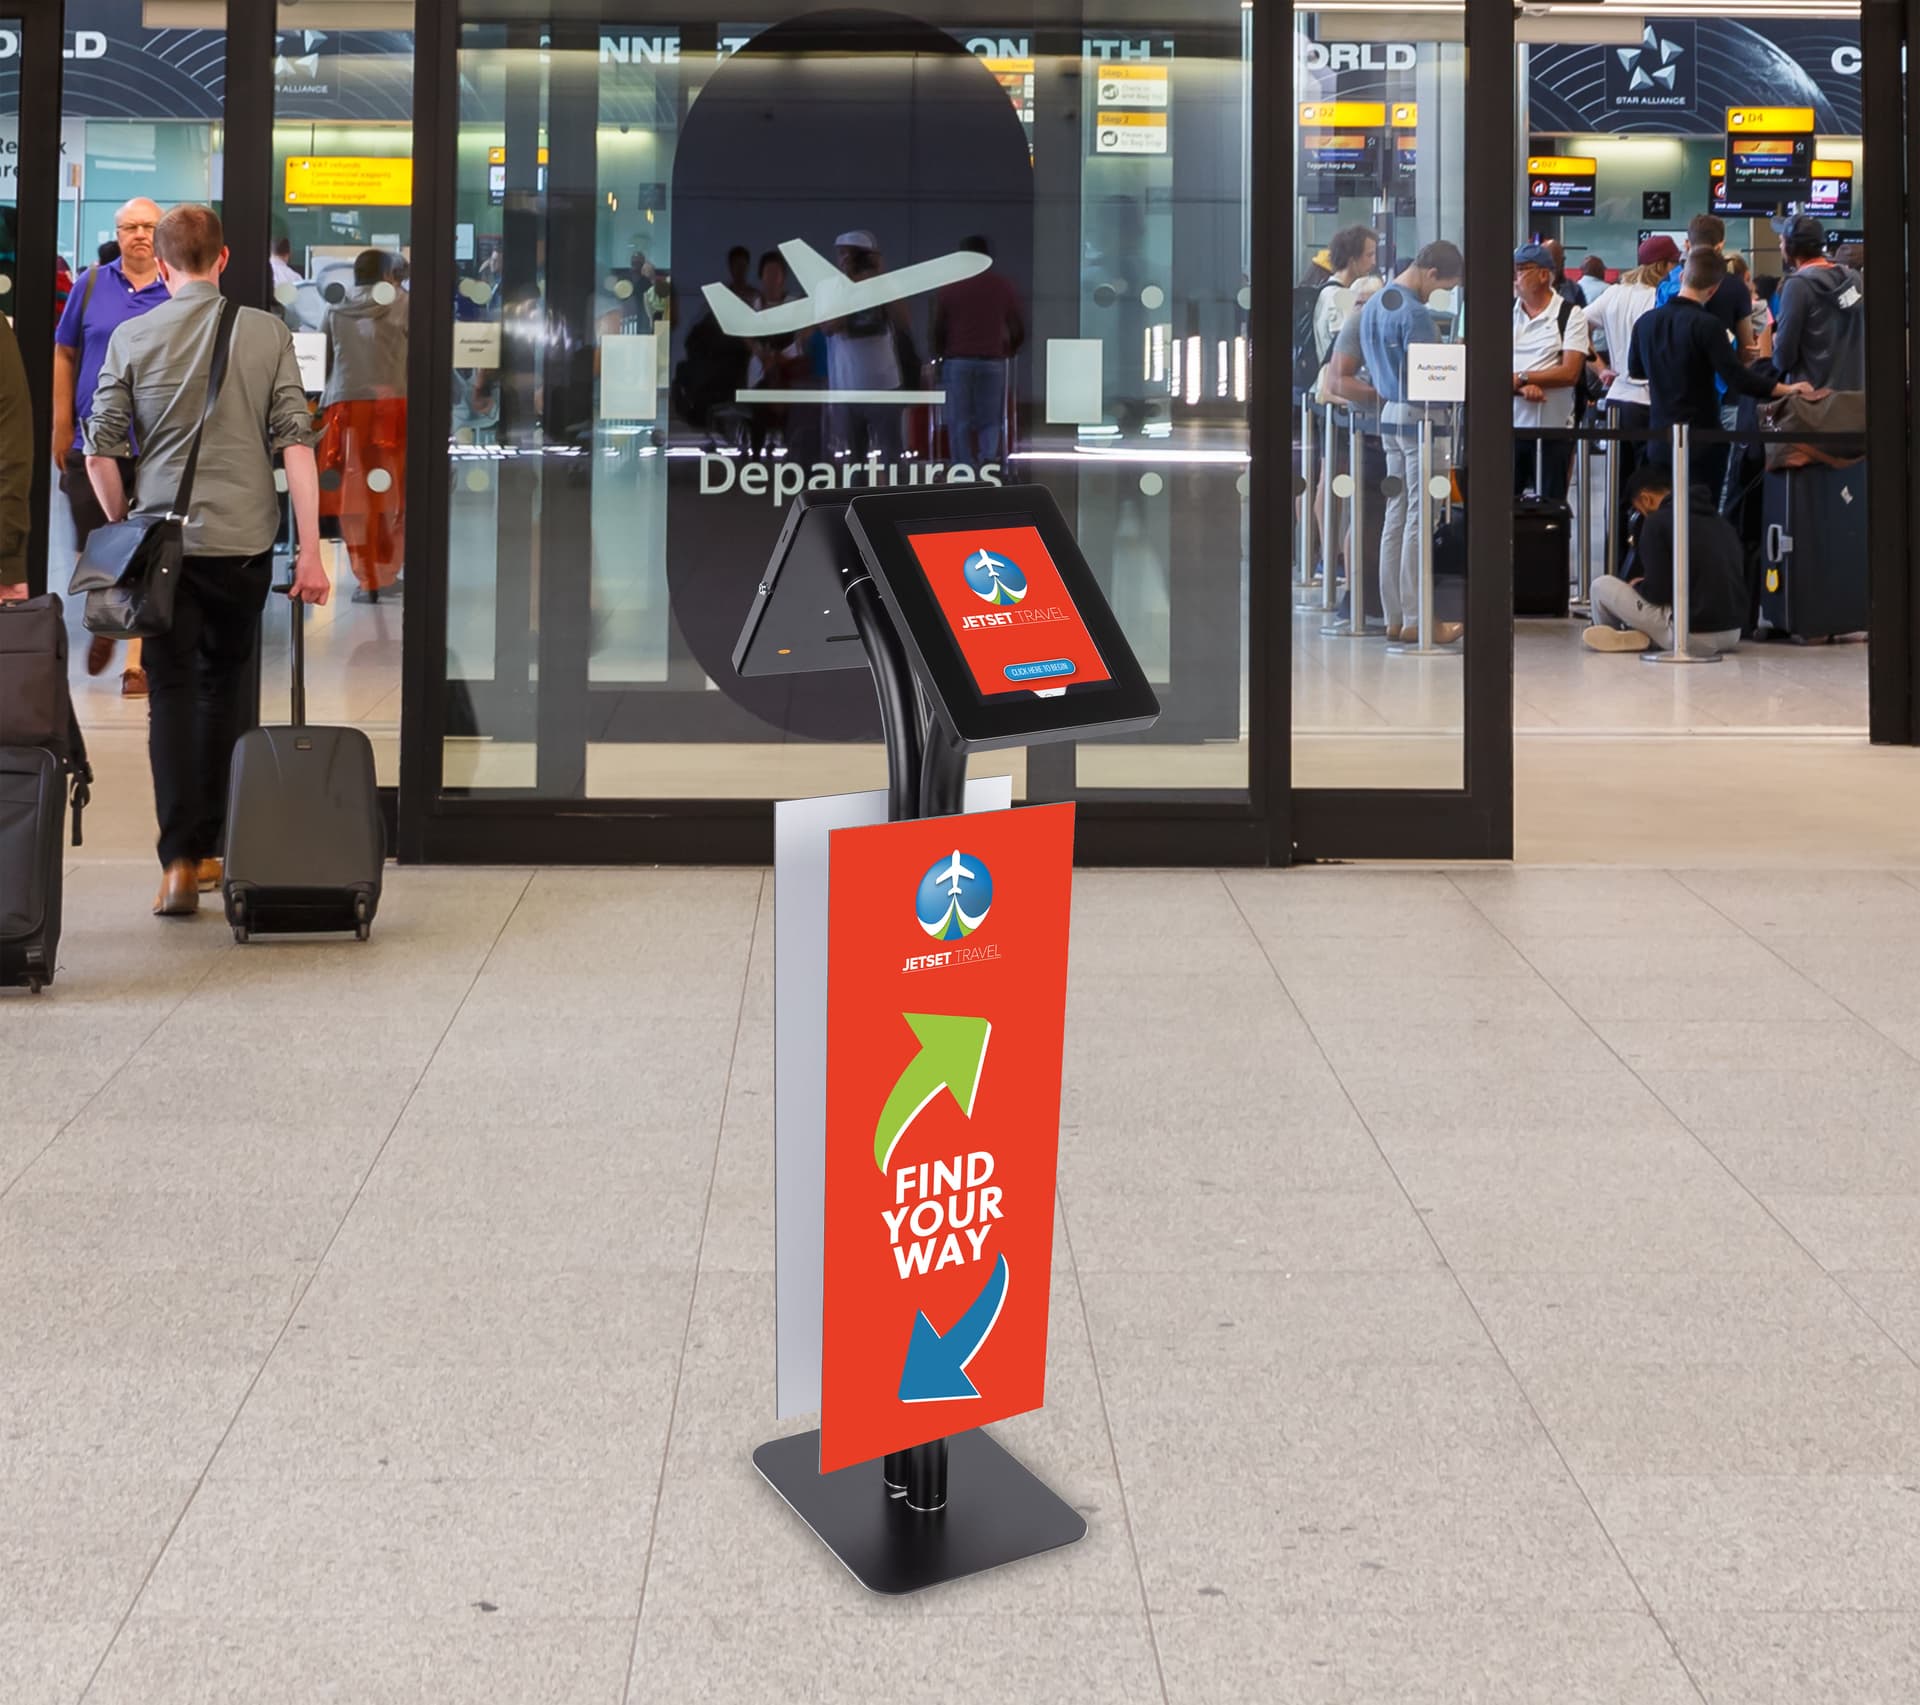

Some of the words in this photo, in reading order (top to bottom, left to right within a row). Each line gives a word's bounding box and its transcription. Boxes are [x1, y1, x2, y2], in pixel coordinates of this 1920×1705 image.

[1615, 96, 1639, 105] STAR
[1640, 96, 1686, 105] ALLIANCE
[1748, 113, 1764, 123] D4
[1417, 363, 1457, 371] Automatic
[700, 453, 1002, 507] Departures
[962, 611, 1012, 629] JETSET
[1014, 606, 1069, 624] TRAVEL
[1011, 668, 1028, 677] CLICK
[1028, 665, 1043, 674] HERE
[1051, 662, 1069, 671] BEGIN
[902, 951, 952, 972] JETSET
[955, 944, 1001, 962] TRAVEL
[896, 1151, 995, 1205] FIND
[881, 1186, 1005, 1244] YOUR
[893, 1224, 992, 1280] WAY
